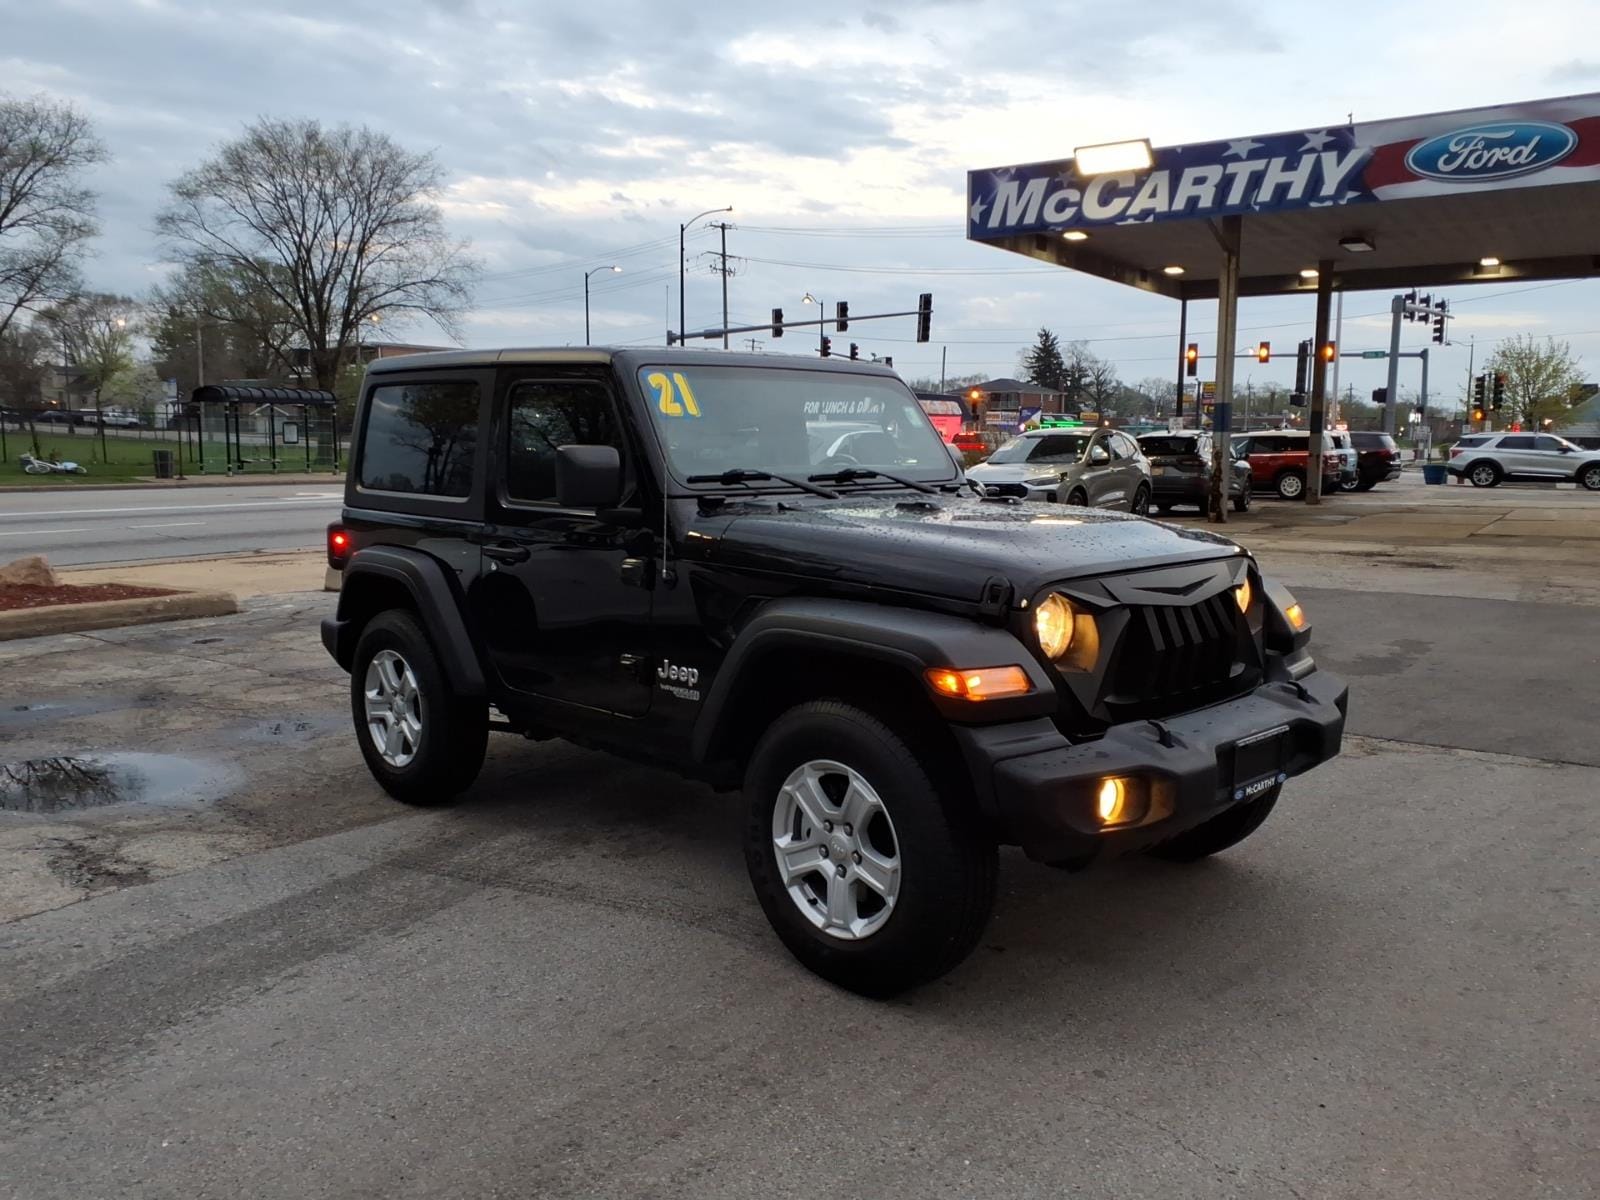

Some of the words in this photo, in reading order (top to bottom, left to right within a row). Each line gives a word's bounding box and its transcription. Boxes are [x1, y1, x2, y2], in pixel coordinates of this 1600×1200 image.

[1437, 130, 1541, 172] Ford
[987, 147, 1369, 228] McCARTHY
[647, 372, 701, 417] 21
[803, 401, 820, 414] FOR
[657, 659, 699, 687] Jeep
